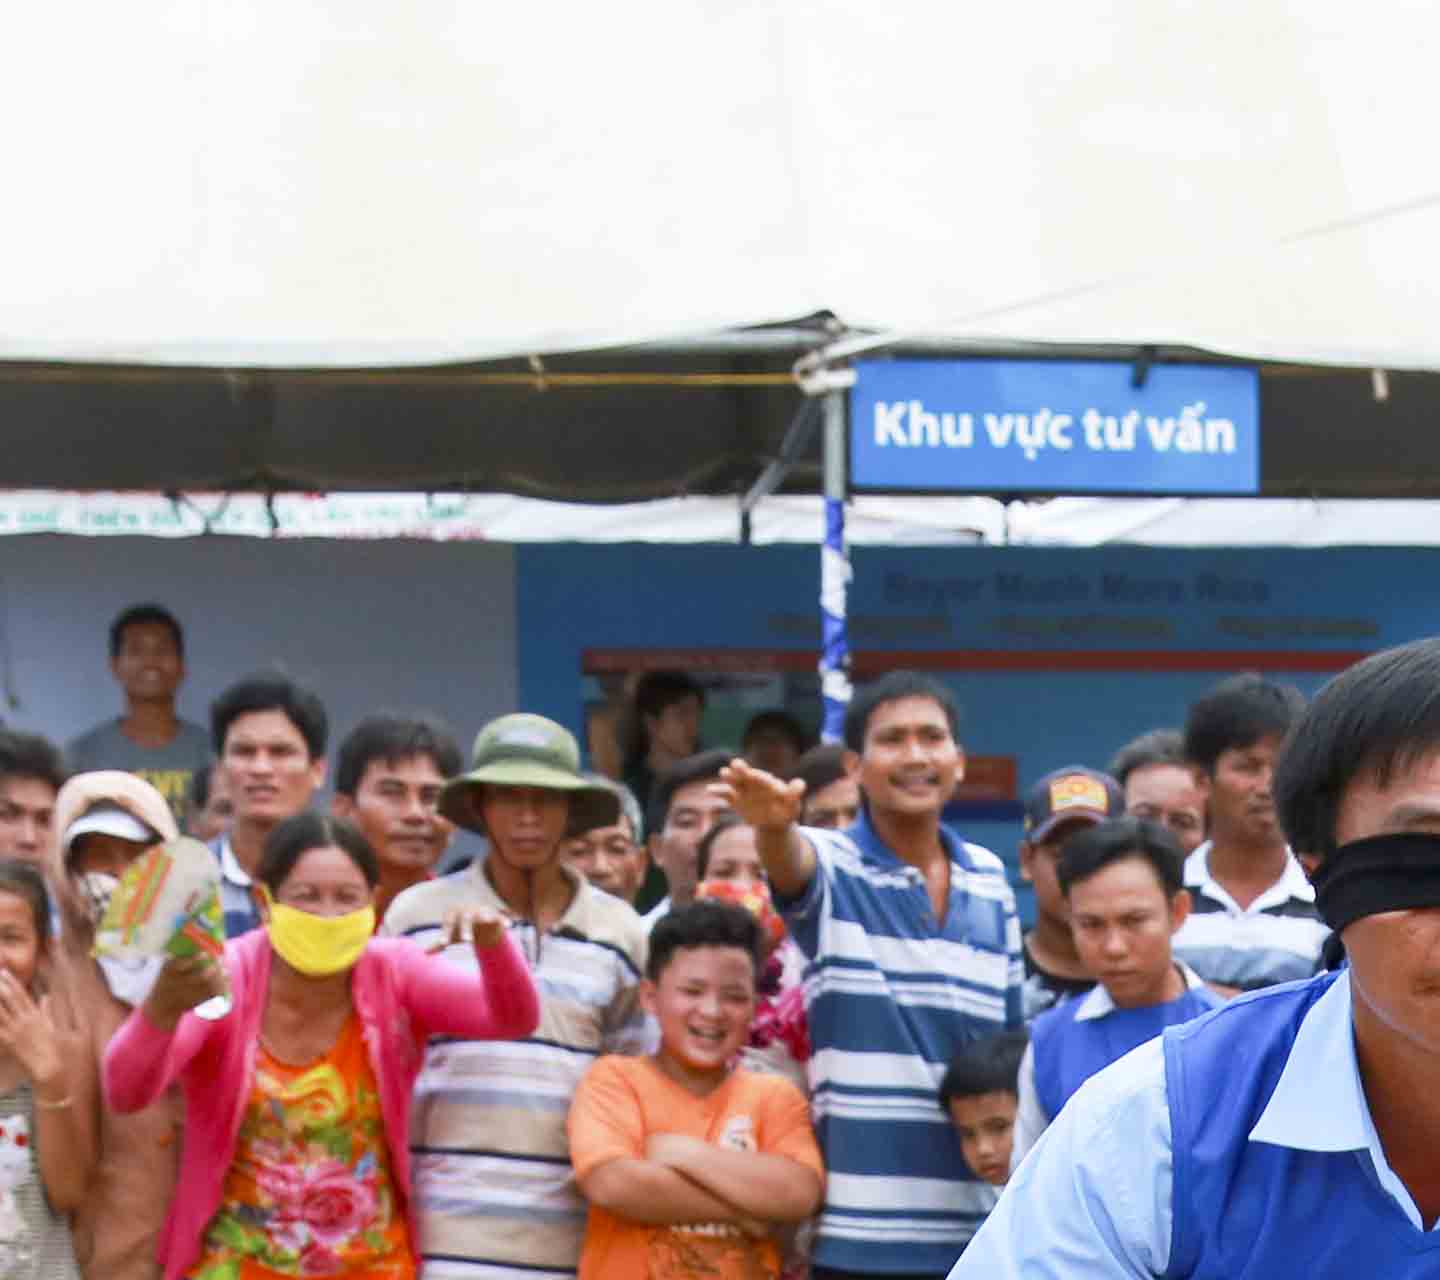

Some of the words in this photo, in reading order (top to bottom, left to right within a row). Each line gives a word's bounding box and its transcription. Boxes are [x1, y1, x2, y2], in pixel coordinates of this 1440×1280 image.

[874, 400, 973, 449] Khu
[984, 407, 1073, 461] vực
[1082, 408, 1140, 451] tư
[1145, 400, 1237, 454] vấn
